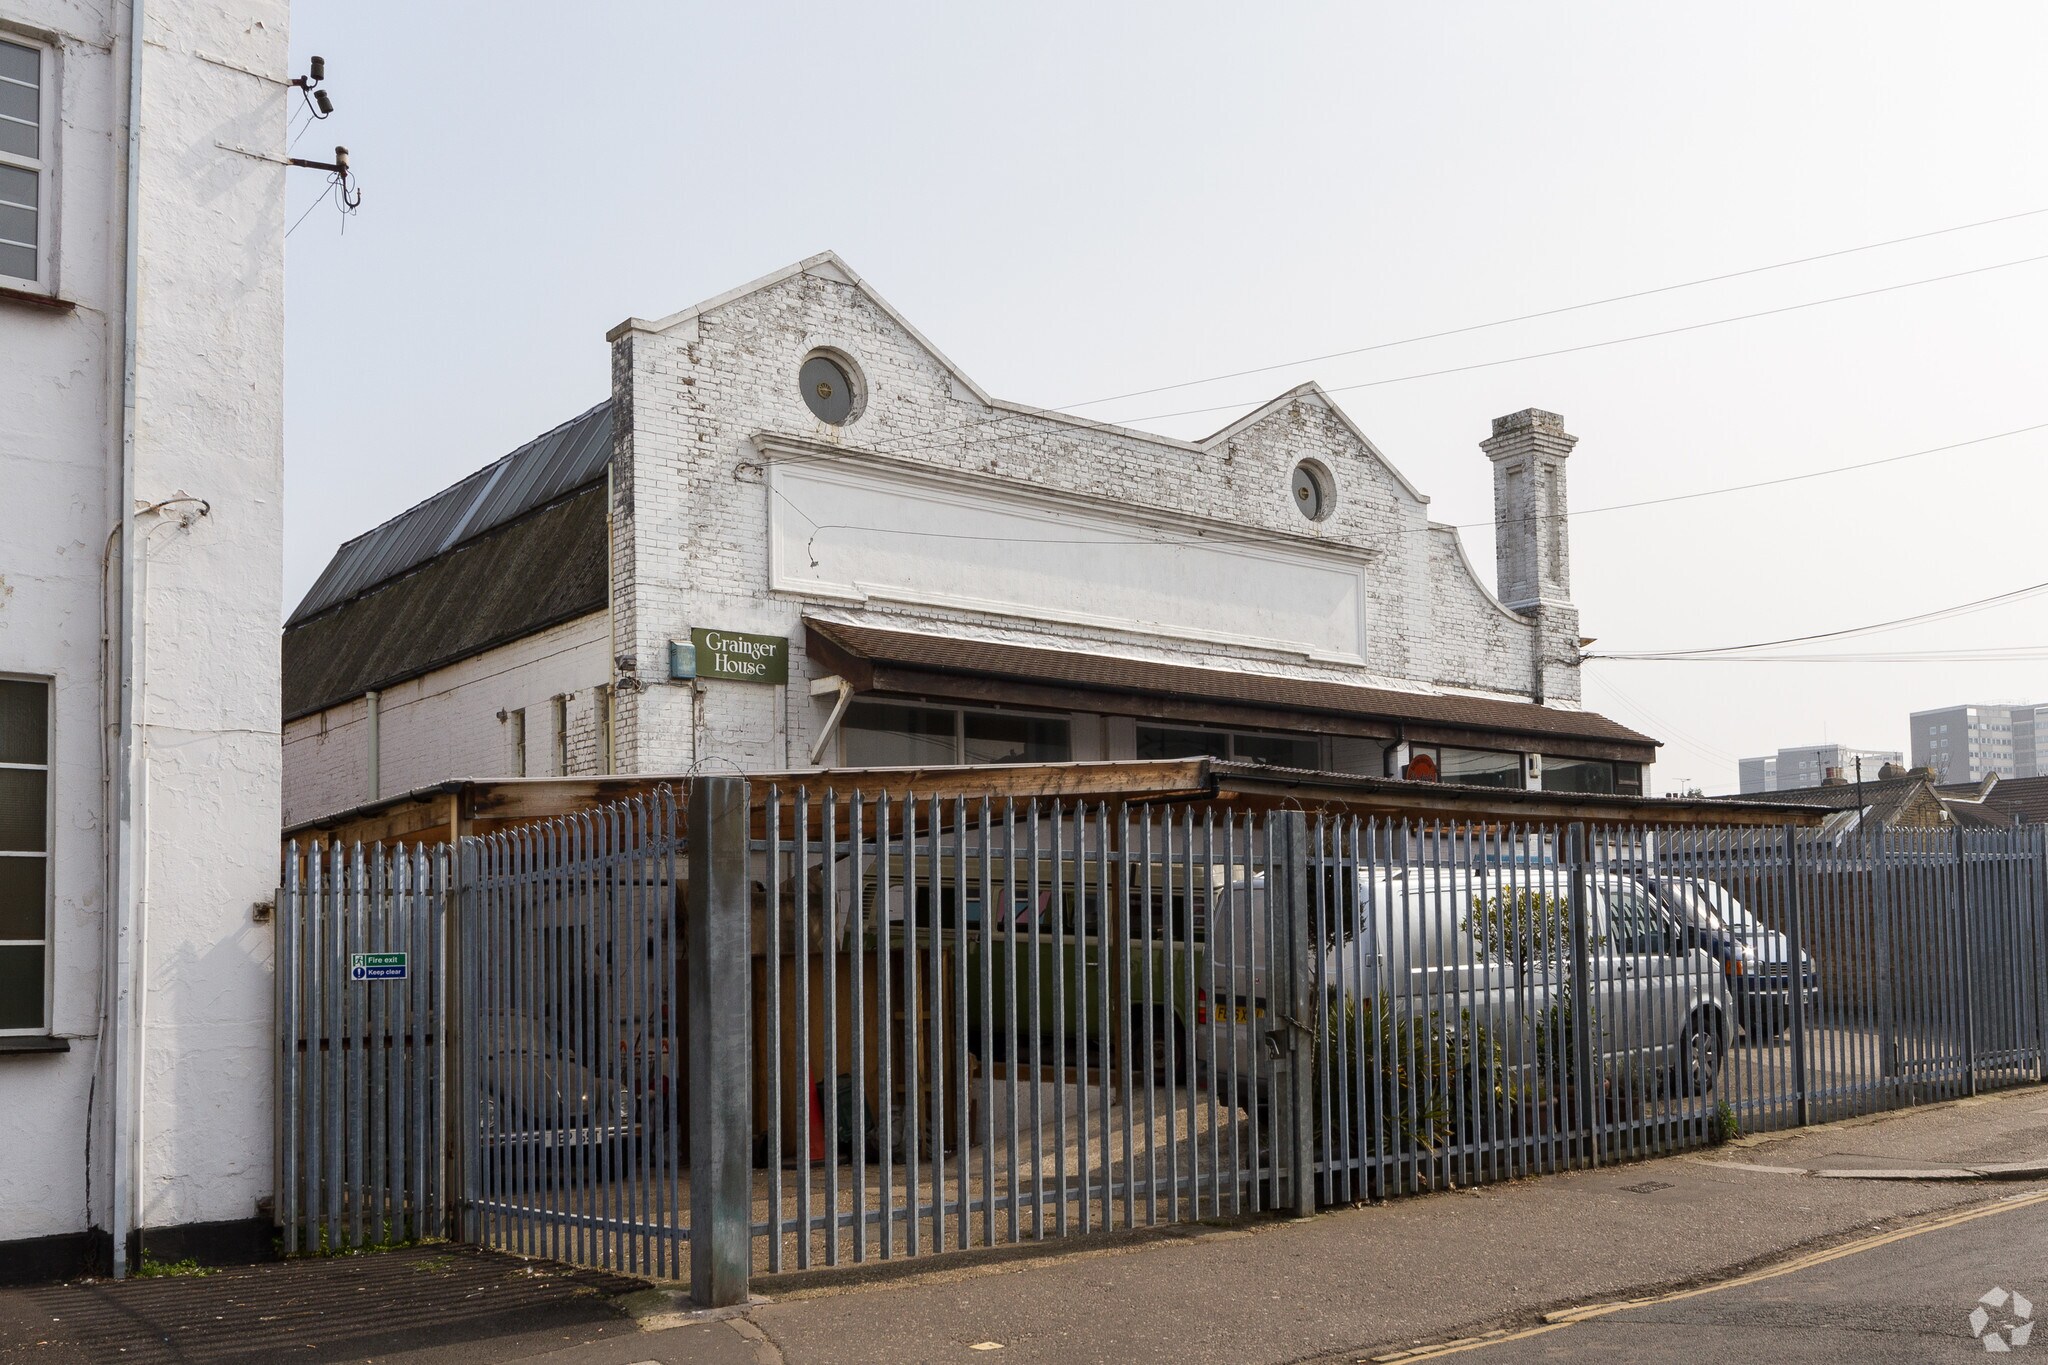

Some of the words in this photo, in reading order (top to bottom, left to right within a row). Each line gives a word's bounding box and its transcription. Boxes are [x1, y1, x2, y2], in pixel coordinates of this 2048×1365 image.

[705, 632, 777, 660] Grainger
[714, 653, 766, 675] House
[368, 956, 383, 964] Fire
